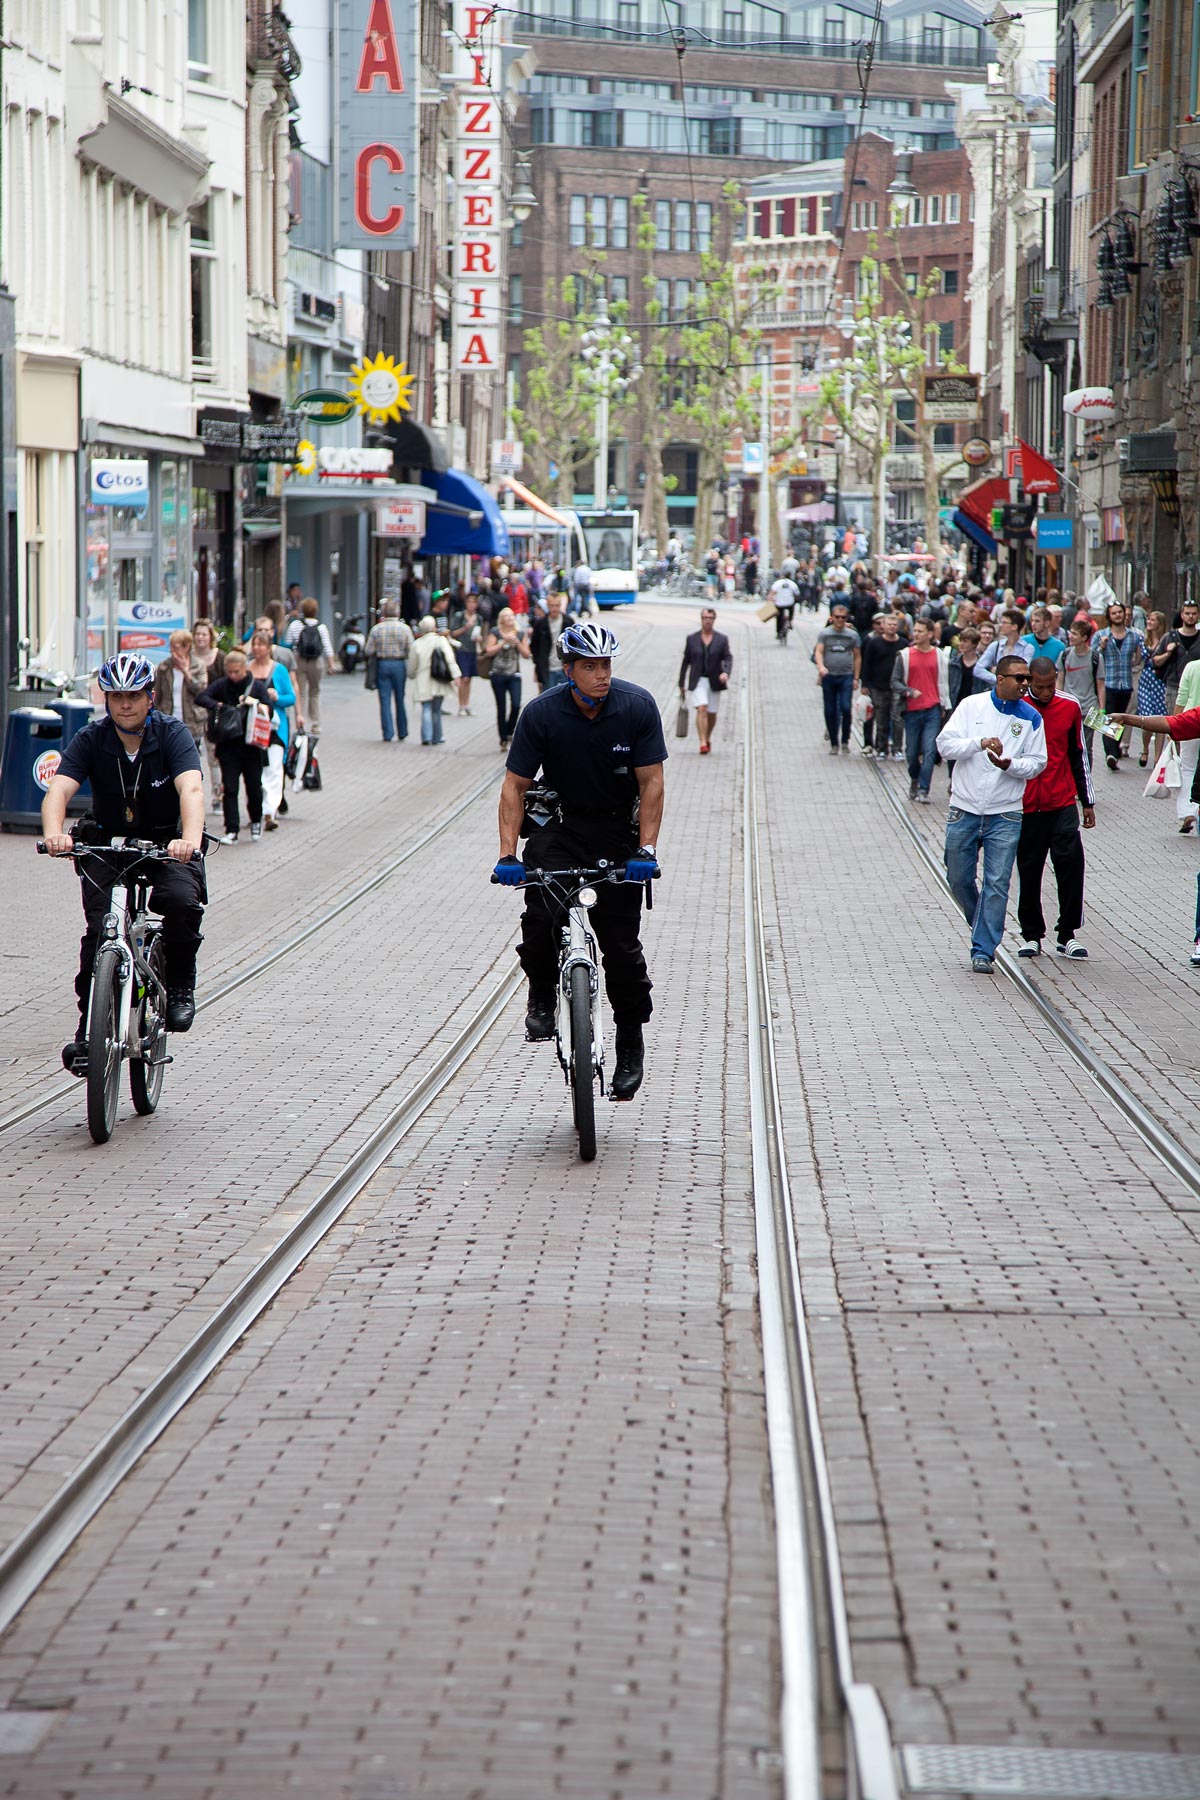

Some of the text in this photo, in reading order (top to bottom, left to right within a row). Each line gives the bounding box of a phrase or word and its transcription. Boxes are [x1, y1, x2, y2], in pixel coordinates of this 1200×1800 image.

[461, 7, 495, 364] PIZZERIA
[296, 400, 353, 416] SUBWAY
[318, 446, 393, 471] CAS
[97, 471, 143, 489] etos
[132, 603, 173, 619] etos
[40, 769, 57, 781] KIN
